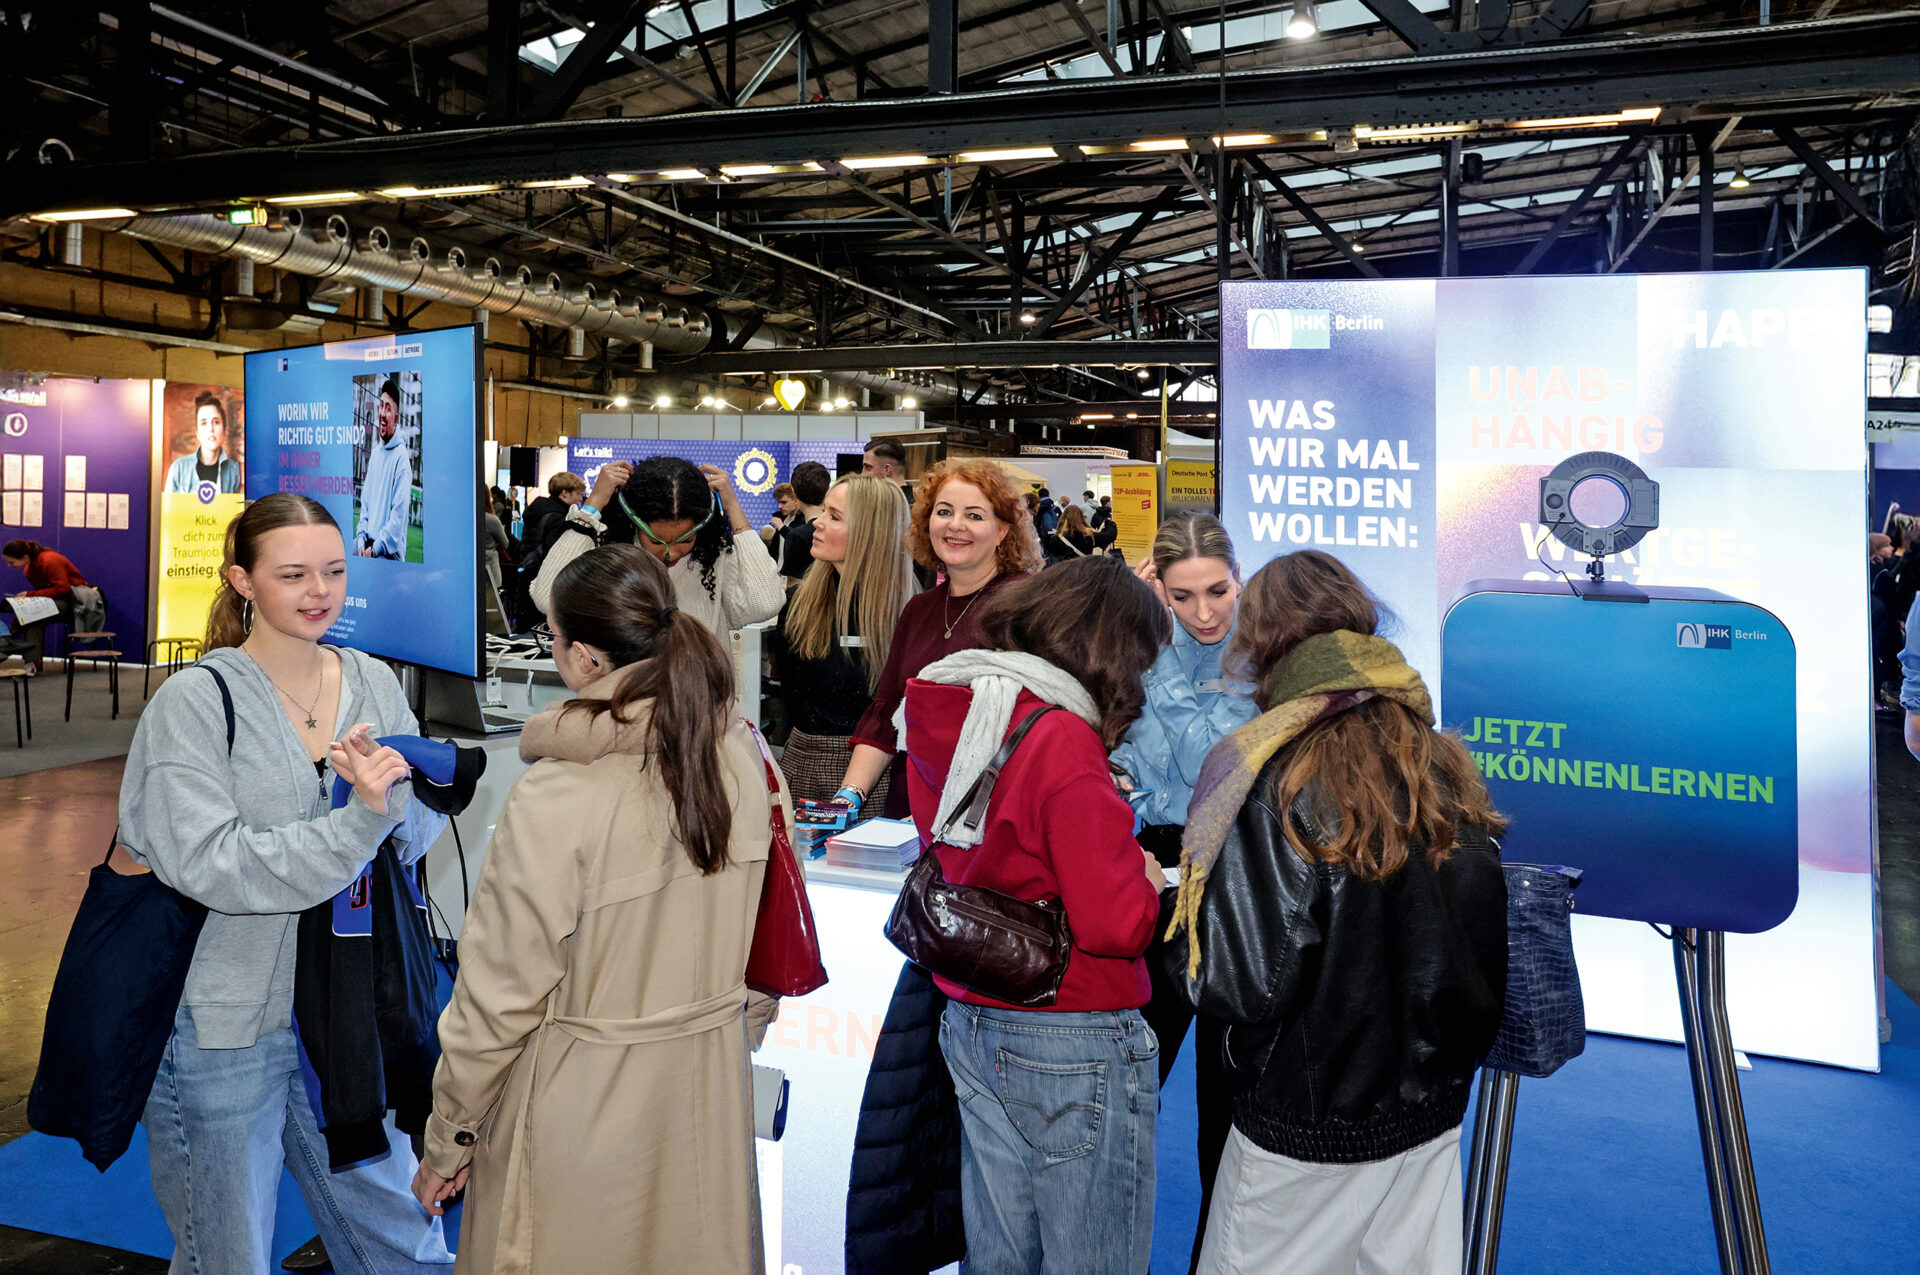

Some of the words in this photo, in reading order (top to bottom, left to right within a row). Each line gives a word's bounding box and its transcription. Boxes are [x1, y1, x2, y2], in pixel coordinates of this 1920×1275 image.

[1294, 314, 1327, 331] IHK
[1335, 314, 1384, 331] Berlin
[1469, 365, 1628, 402] UNAB-
[278, 403, 308, 421] WORIN
[310, 401, 329, 420] WIR
[1248, 399, 1336, 431] WAS
[278, 427, 314, 446] RICHTIG
[315, 426, 335, 445] GUT
[337, 425, 366, 446] SIND?
[1470, 405, 1664, 454] HÄNGIG
[278, 452, 289, 468] IM
[291, 452, 321, 469] IMMER
[1248, 436, 1326, 468] WIR
[1337, 438, 1420, 471] MAL
[1171, 469, 1195, 477] Deutsche
[278, 474, 312, 494] BESSER
[1248, 474, 1412, 509] WERDEN
[195, 515, 217, 526] Klick
[1248, 512, 1419, 548] WOLLEN:
[183, 530, 205, 542] dich
[173, 546, 219, 560] Traumjob
[167, 563, 221, 578] einstieg.
[1707, 628, 1730, 638] IHK
[1735, 629, 1768, 640] Berlin
[1464, 716, 1567, 748] JETZT
